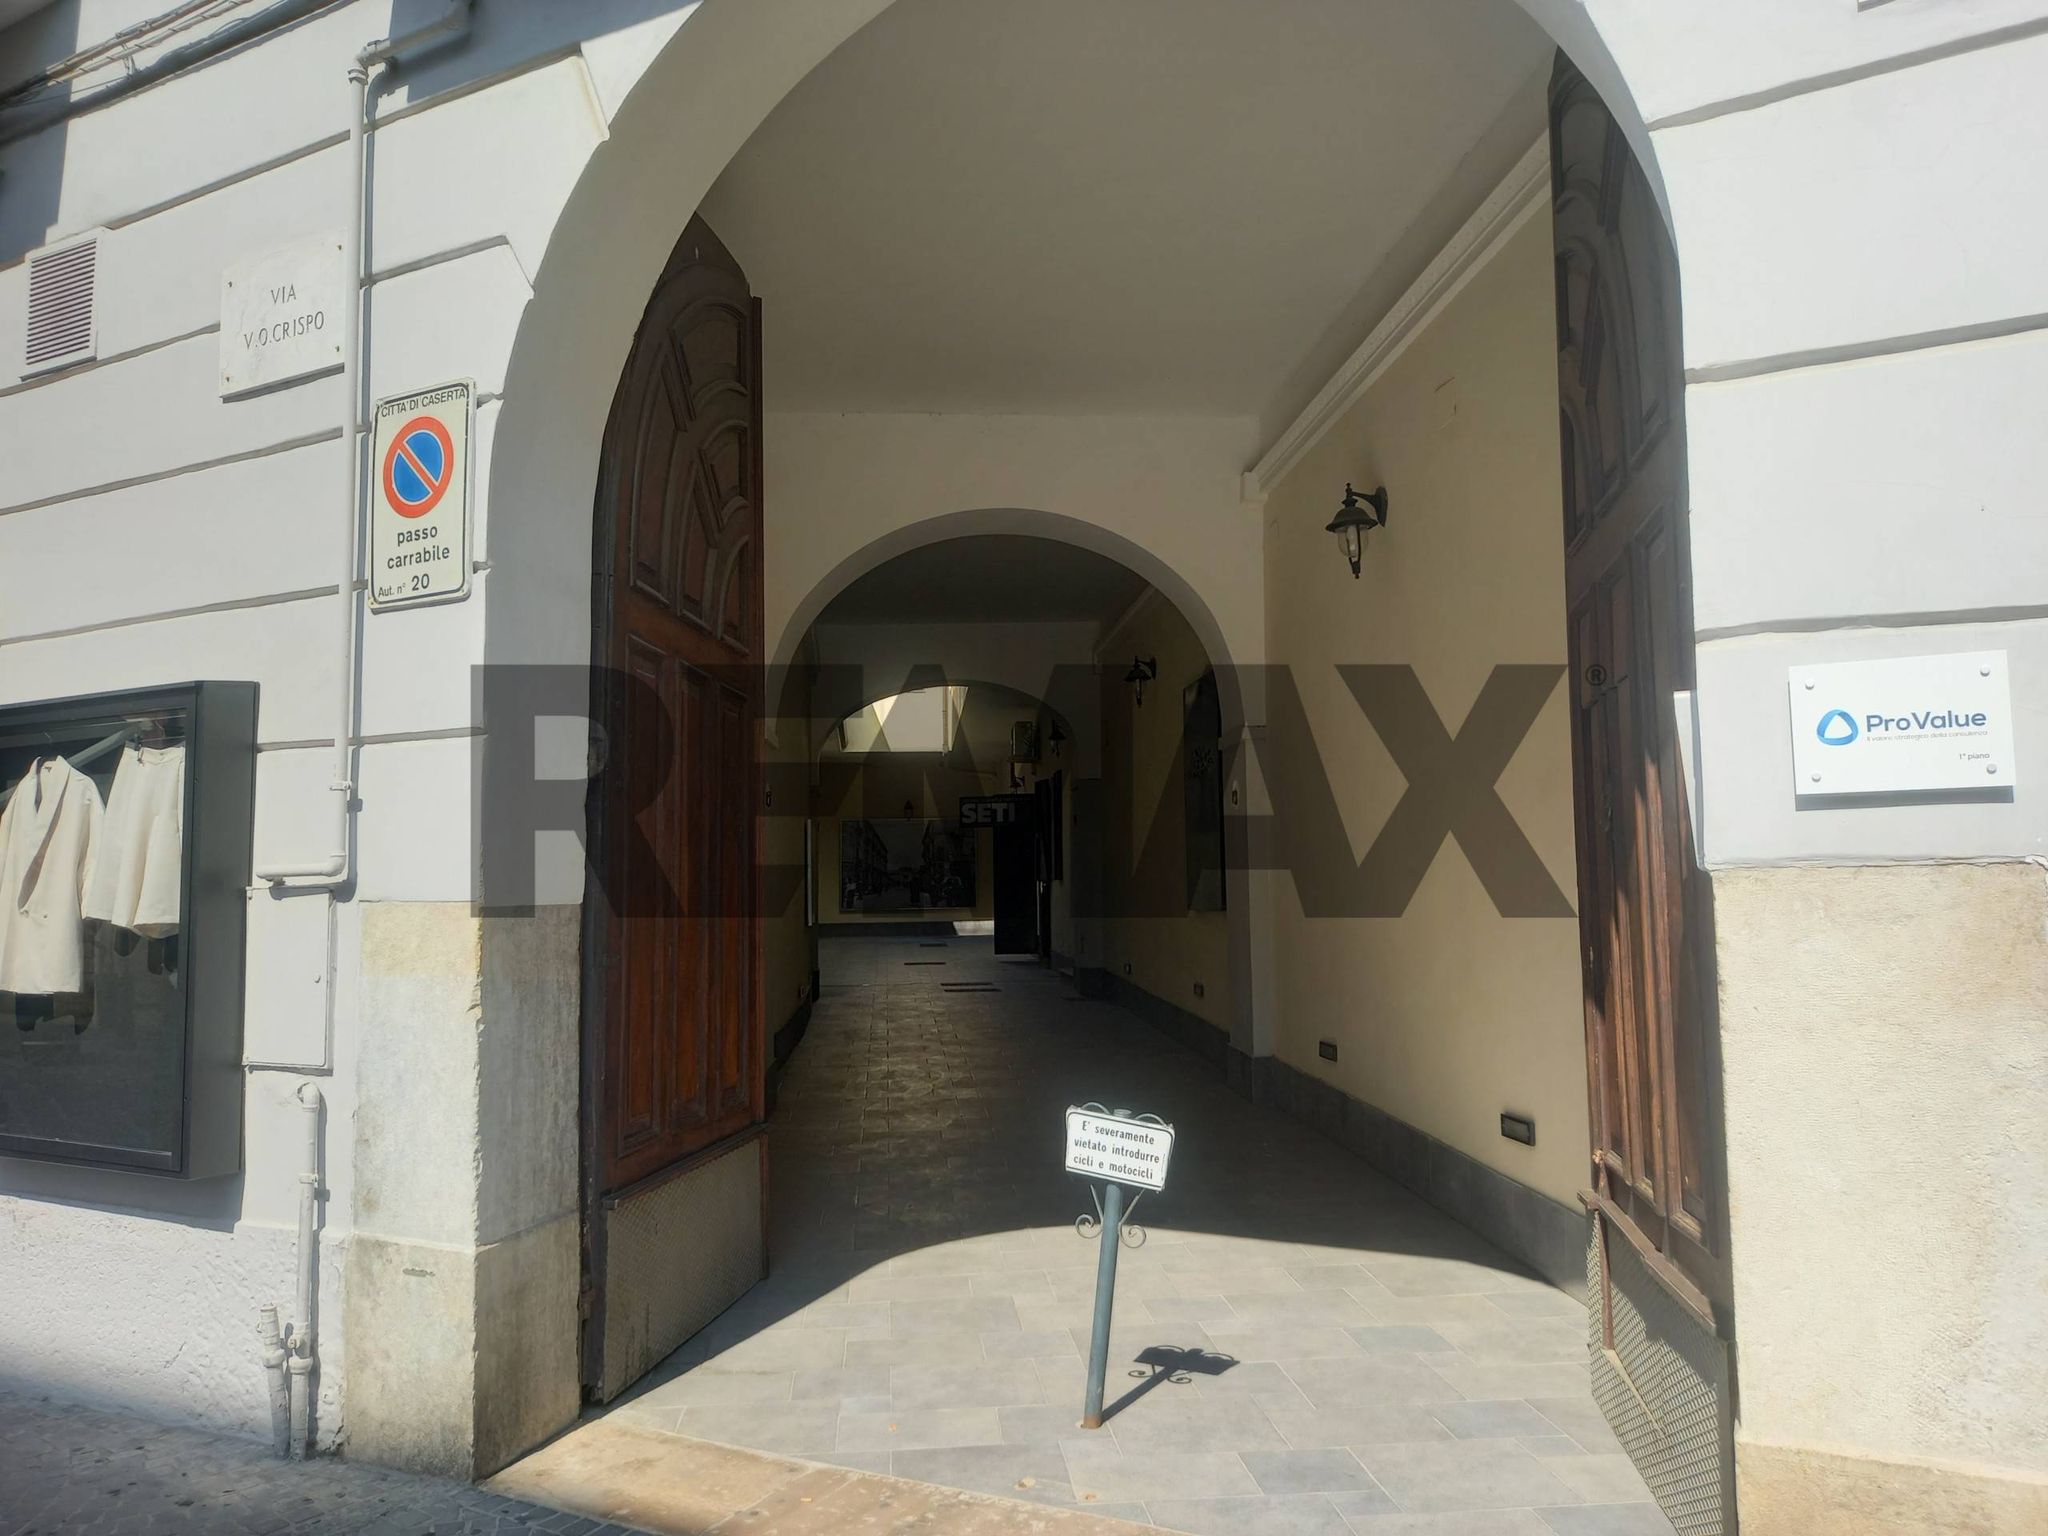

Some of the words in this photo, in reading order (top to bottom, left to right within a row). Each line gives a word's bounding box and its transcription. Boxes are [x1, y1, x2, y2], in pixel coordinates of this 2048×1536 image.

[270, 283, 297, 304] VIA
[409, 398, 419, 411] DI
[421, 388, 466, 407] CASERTA
[397, 526, 438, 547] passo
[387, 545, 450, 569] carrabile
[378, 585, 395, 598] Aut.
[411, 573, 430, 591] 20
[1865, 710, 1987, 732] ProValue
[1967, 752, 1990, 761] piano
[1082, 1120, 1091, 1132] E'
[1095, 1125, 1155, 1145] severamente
[1074, 1137, 1107, 1153] vietato
[1112, 1143, 1160, 1164] introdurre
[1073, 1154, 1094, 1167] cicli
[1098, 1160, 1104, 1169] e
[1109, 1162, 1153, 1180] motocicli
